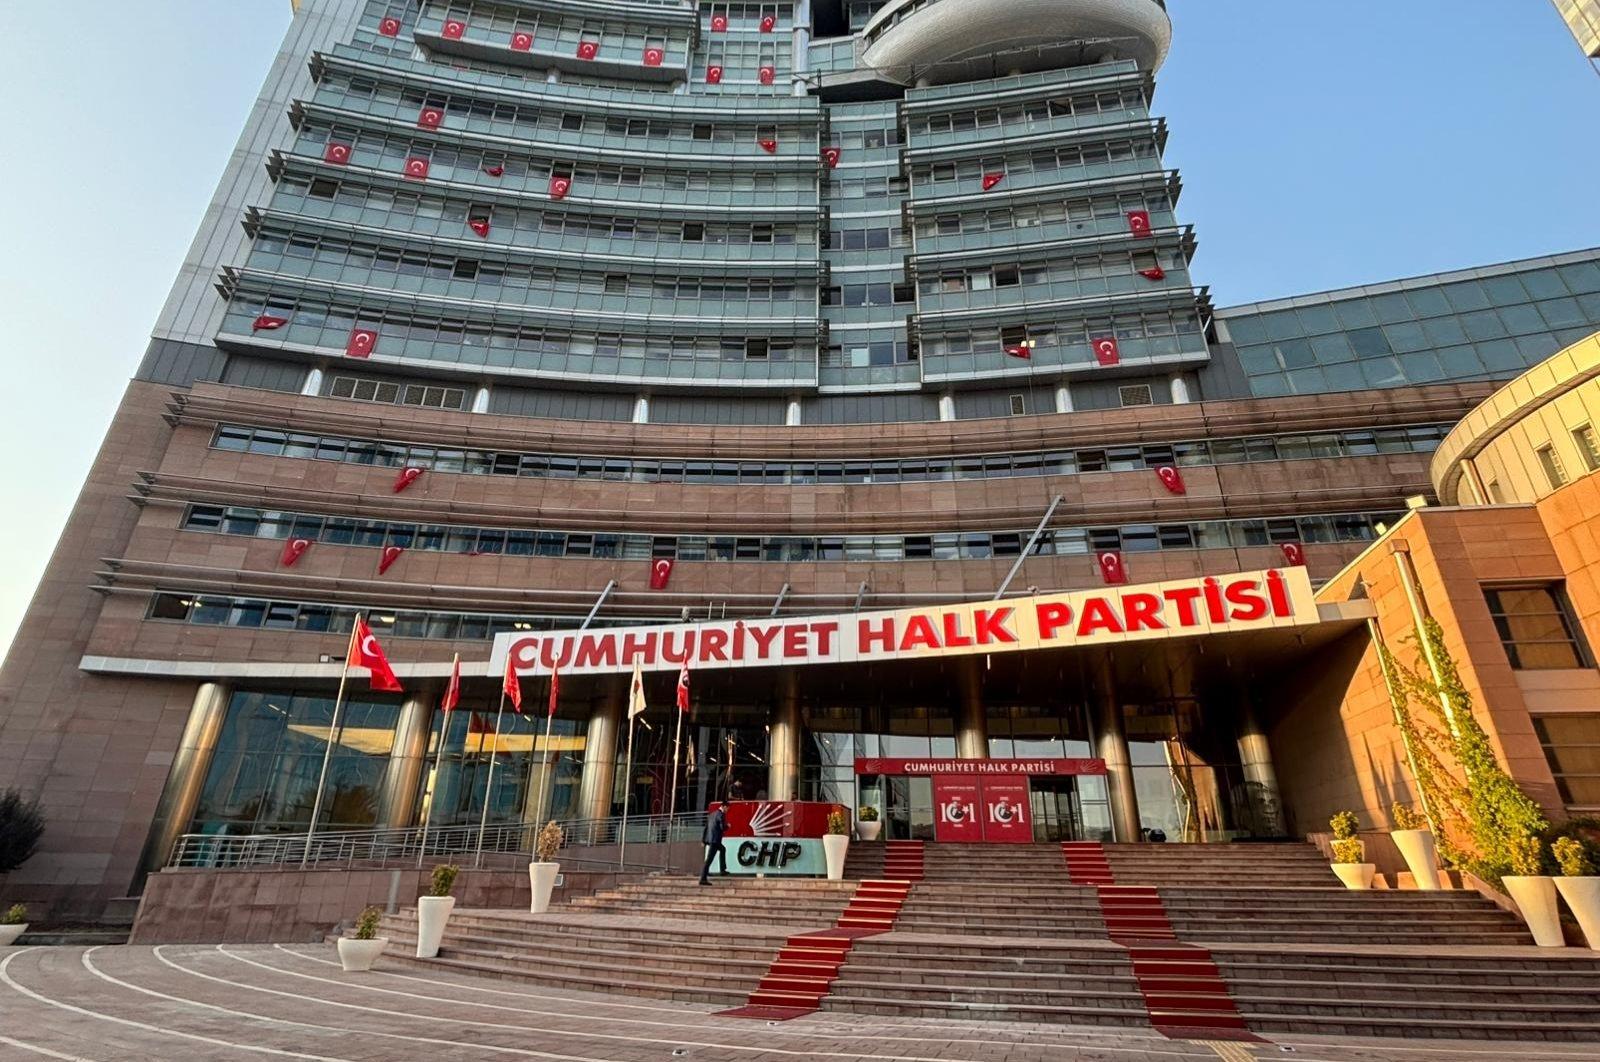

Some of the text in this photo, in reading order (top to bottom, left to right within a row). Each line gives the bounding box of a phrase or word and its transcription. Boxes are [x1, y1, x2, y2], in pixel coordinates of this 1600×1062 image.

[508, 569, 1295, 670] CUMHURİYET HALK PARTİSİ
[904, 760, 1055, 773] CUMHURİYET HALK PARTİSİ
[737, 840, 802, 867] CHP
